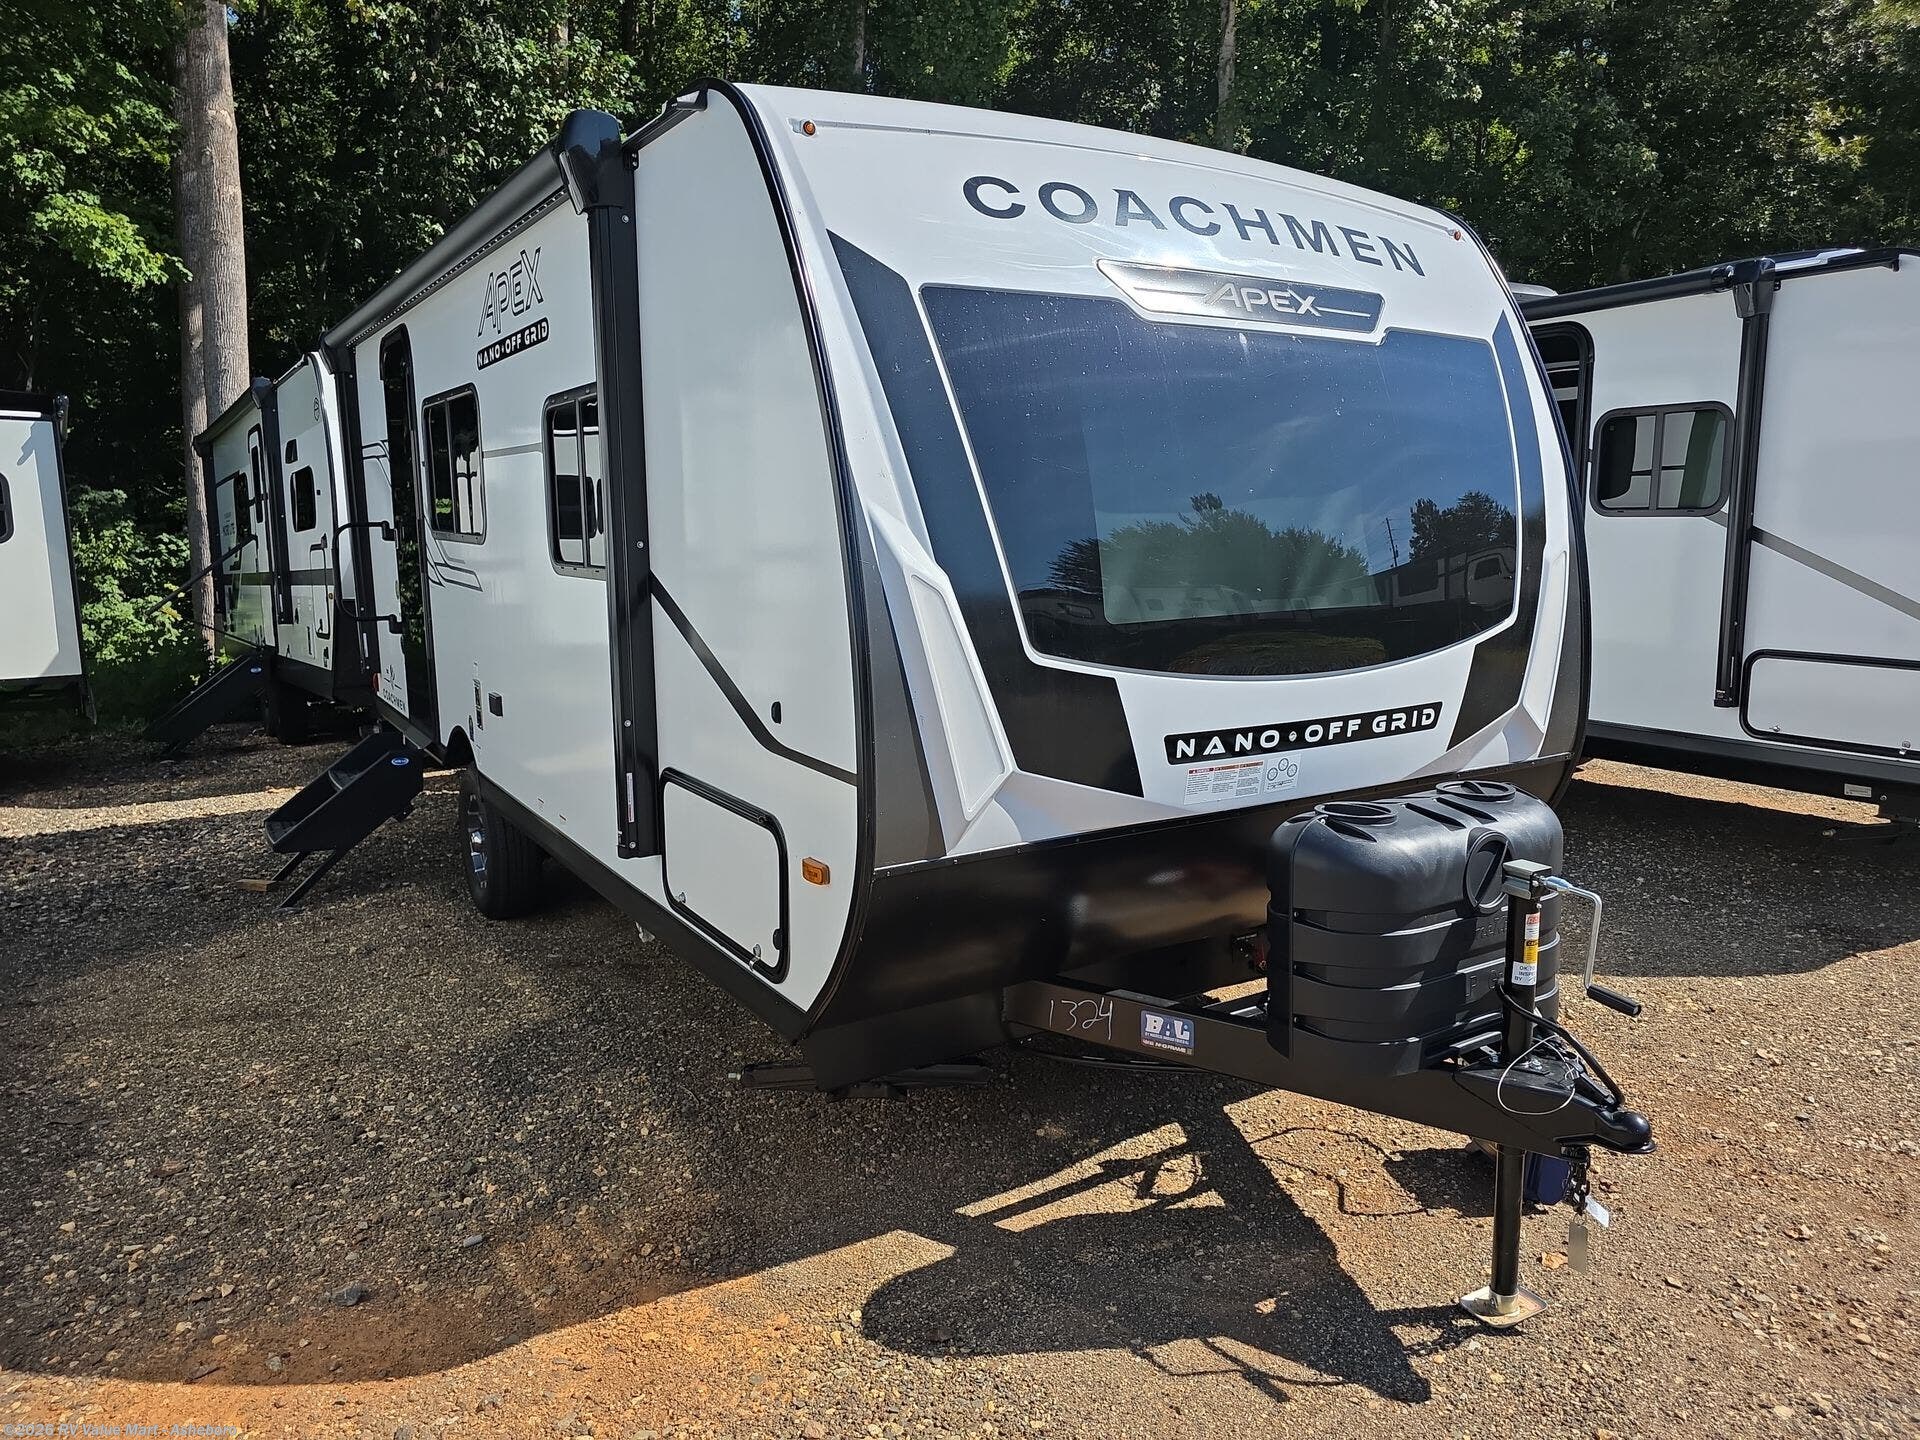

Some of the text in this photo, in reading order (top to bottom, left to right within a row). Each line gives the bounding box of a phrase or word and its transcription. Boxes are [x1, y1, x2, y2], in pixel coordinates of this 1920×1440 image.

[963, 175, 1426, 276] COACHMEN
[478, 246, 544, 337] APEX
[1204, 282, 1322, 317] APEX
[477, 321, 548, 367] NANO OFF GRID
[1176, 709, 1435, 758] NANO OFF GRID
[1049, 997, 1113, 1041] 1324
[1145, 1014, 1190, 1040] BAL
